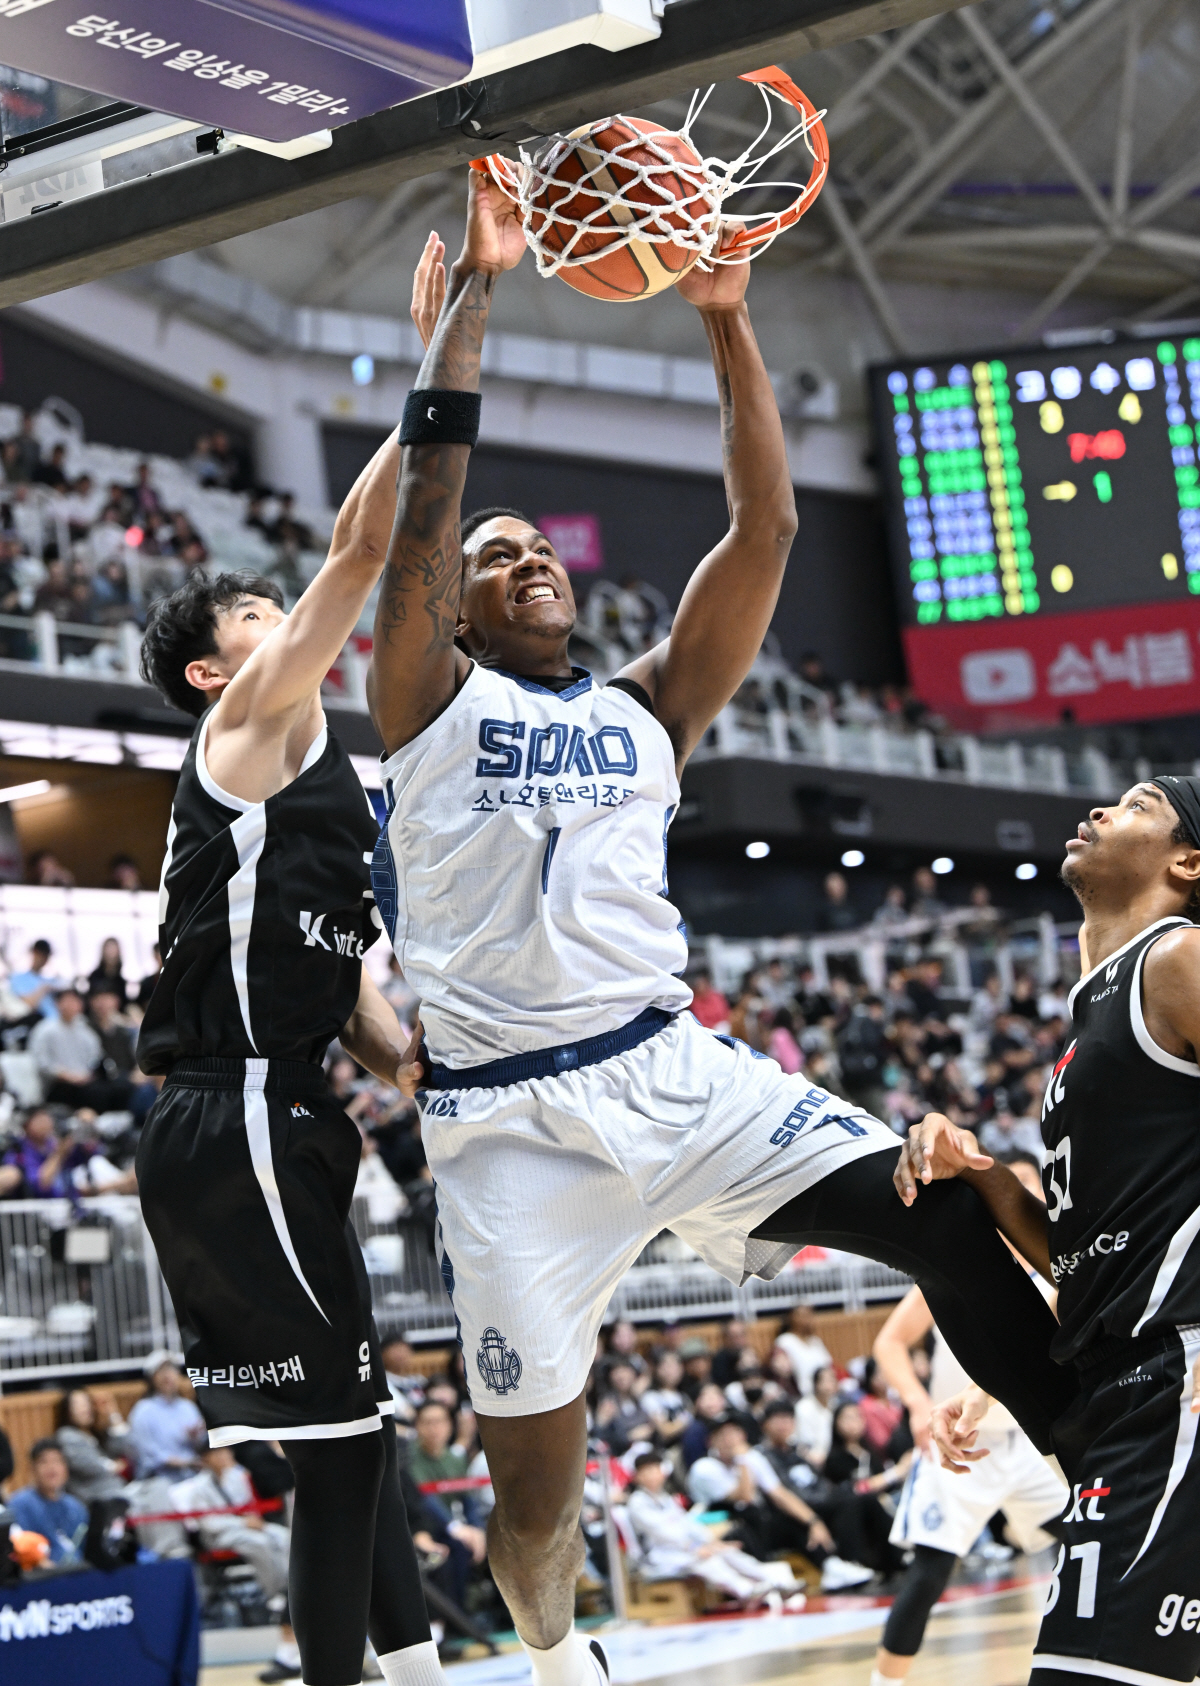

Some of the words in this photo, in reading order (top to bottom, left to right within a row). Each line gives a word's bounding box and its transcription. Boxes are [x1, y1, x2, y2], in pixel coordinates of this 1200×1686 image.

[65, 14, 182, 59] 당신의
[162, 49, 270, 90] 일상을
[256, 81, 350, 116] 1밀리+
[186, 1354, 306, 1389] 밀리의서재
[1118, 1374, 1153, 1387] KAMISTA
[1062, 1477, 1111, 1522] kt
